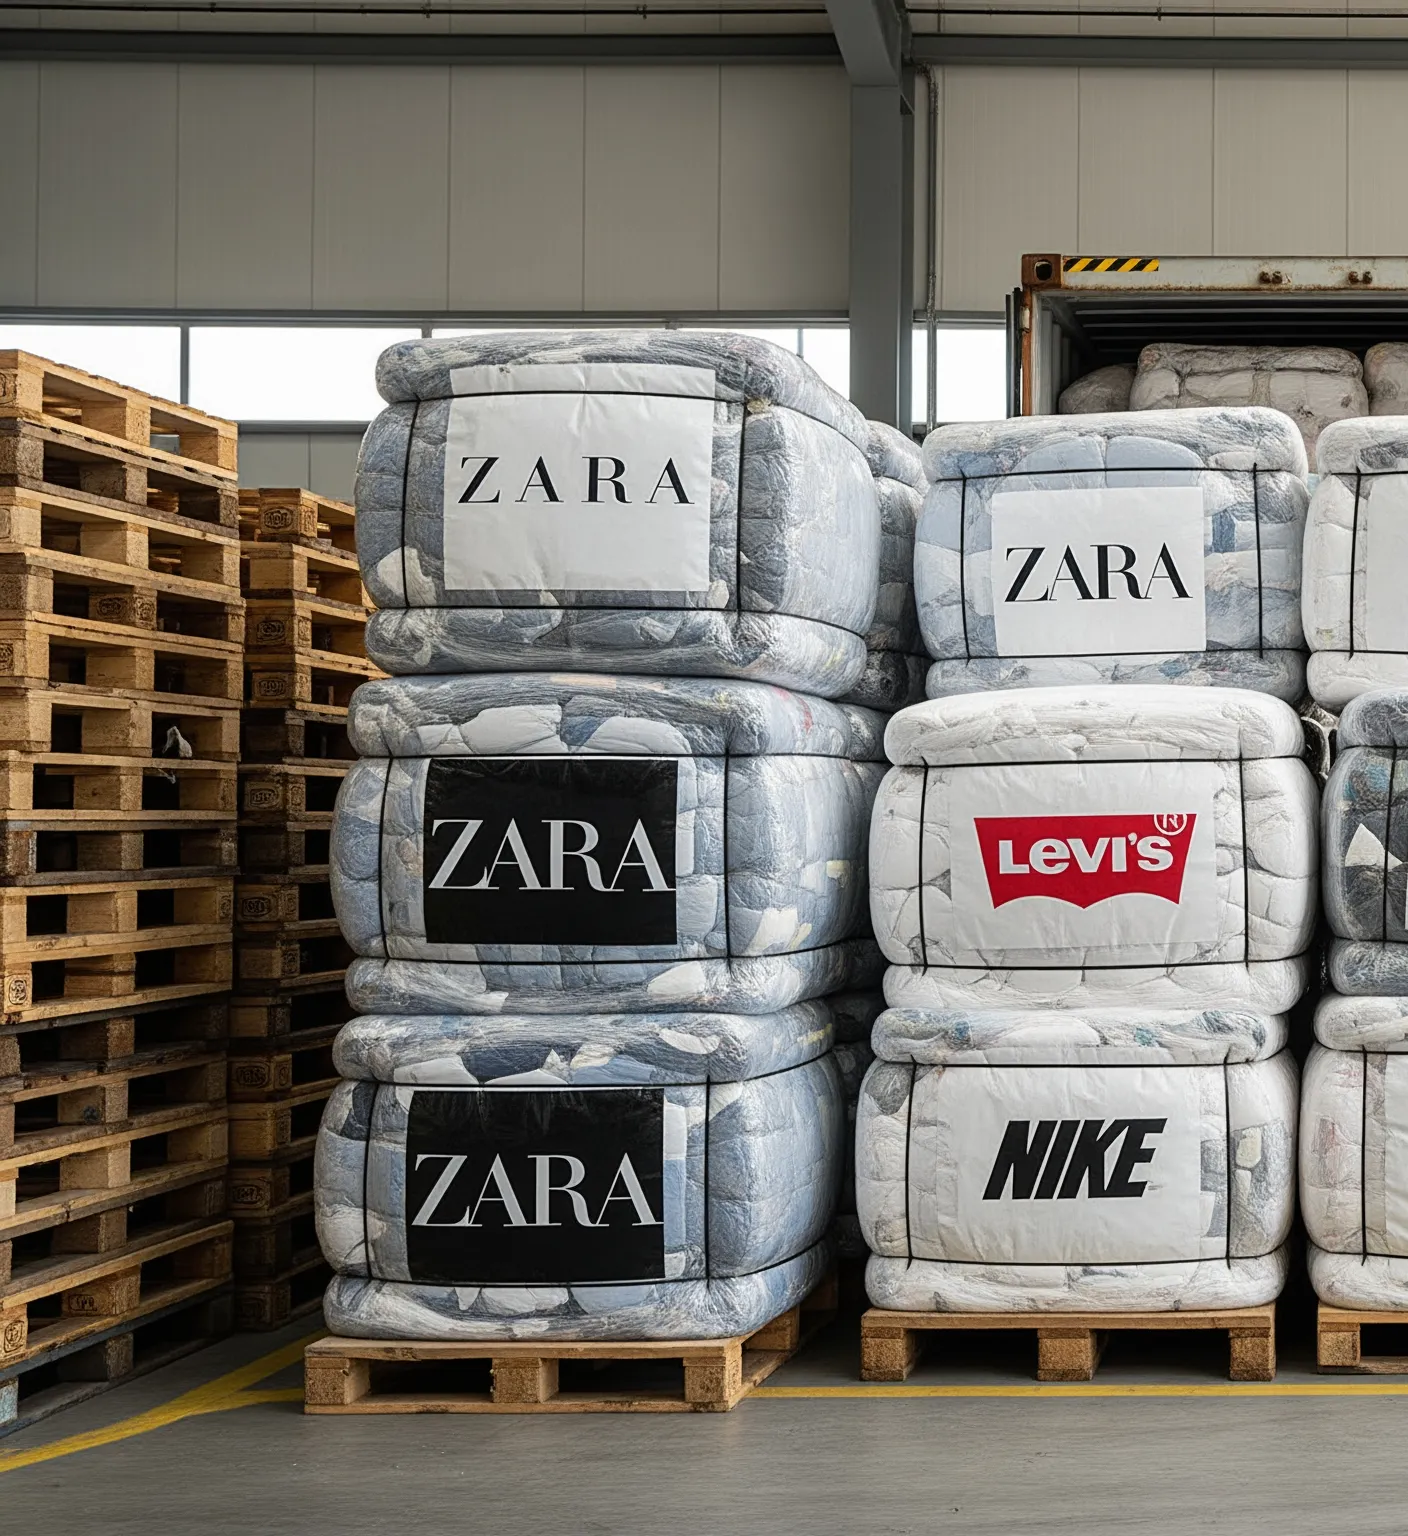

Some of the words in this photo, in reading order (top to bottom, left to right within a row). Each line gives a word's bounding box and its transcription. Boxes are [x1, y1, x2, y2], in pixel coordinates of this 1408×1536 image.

[457, 455, 695, 505] ZARA
[1005, 542, 1193, 602] ZARA
[428, 817, 677, 894] ZARA
[412, 1152, 665, 1229] ZARA
[982, 1117, 1168, 1201] NIKE
